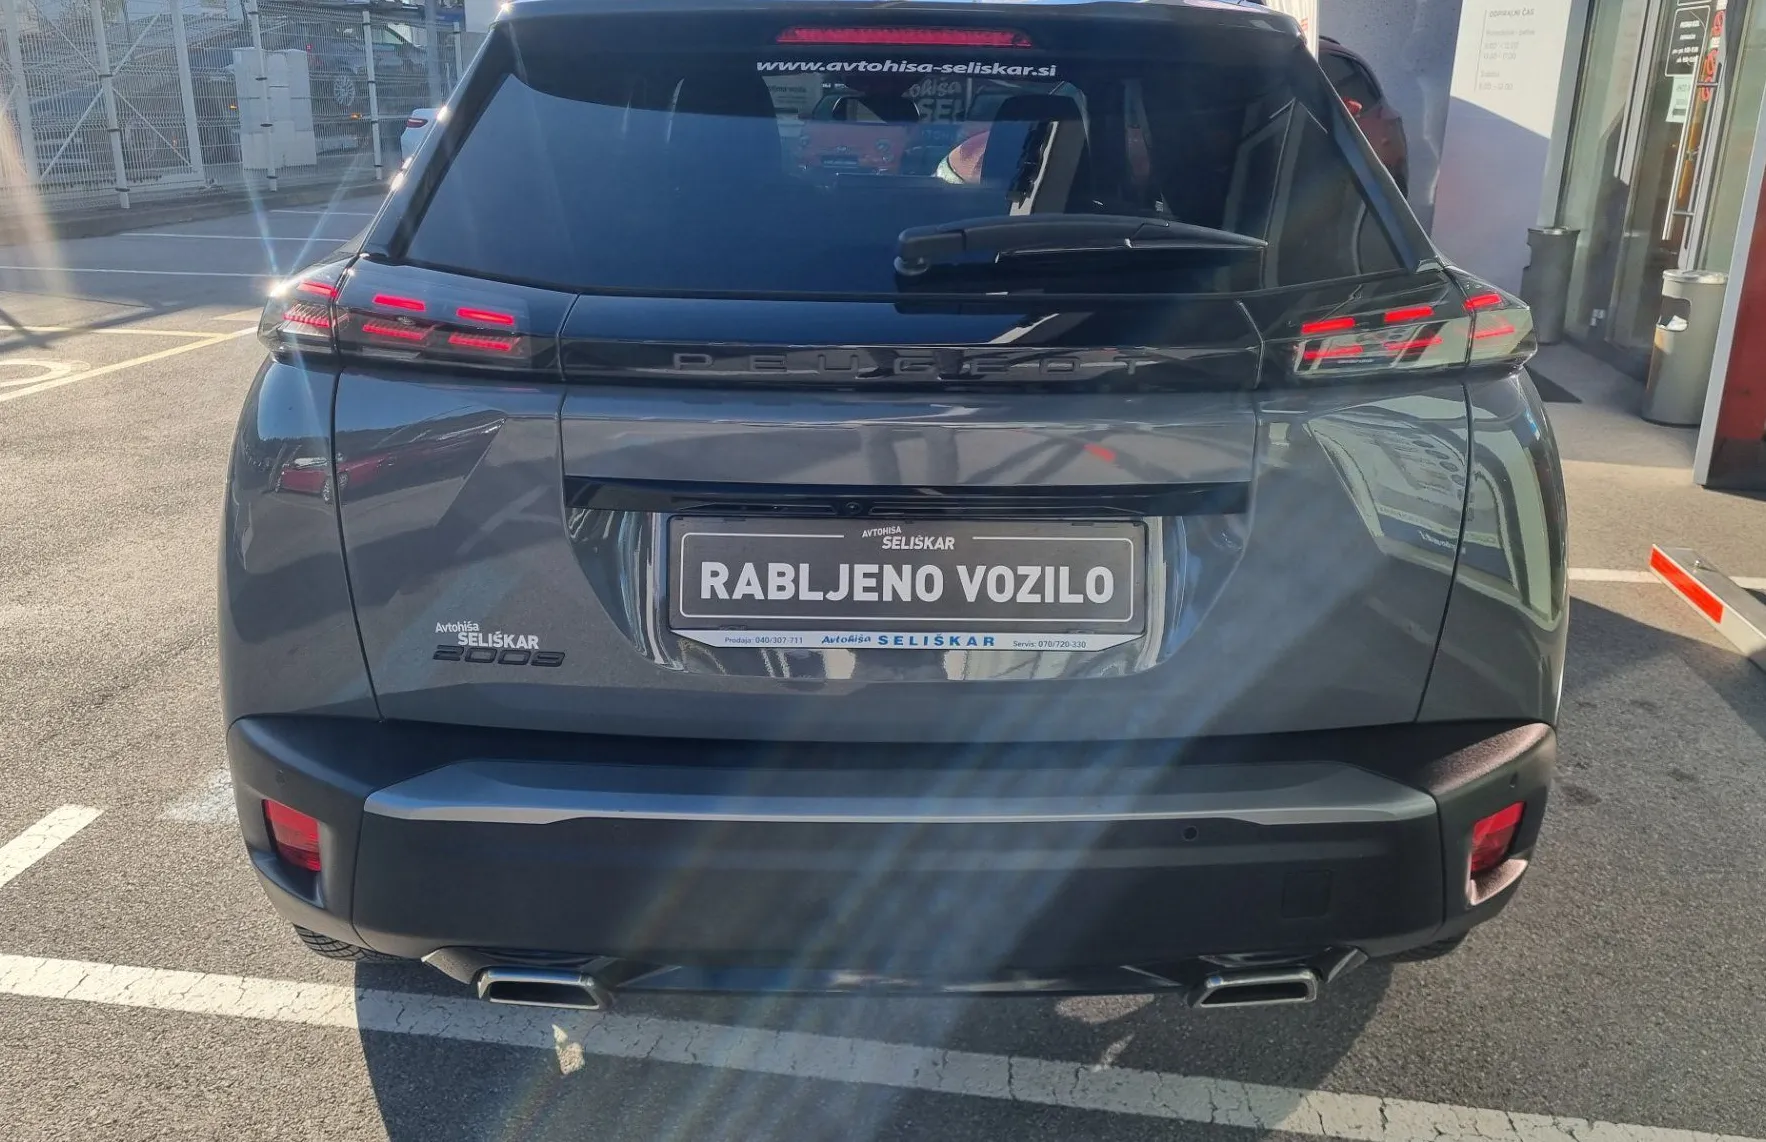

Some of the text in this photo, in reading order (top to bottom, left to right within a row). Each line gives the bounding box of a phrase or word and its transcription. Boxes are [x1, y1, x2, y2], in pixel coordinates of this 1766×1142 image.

[756, 59, 1057, 77] www.avtohisa-seliskar.si
[673, 353, 1148, 376] PEUGEOT
[881, 534, 955, 550] SELIŠKAR
[700, 561, 1114, 604] RABLJENO VOZILO
[457, 631, 540, 649] SELIŠKAR
[877, 633, 995, 647] SELIŠKAR
[1037, 640, 1087, 648] 070/720-330
[432, 644, 566, 668] 2008
